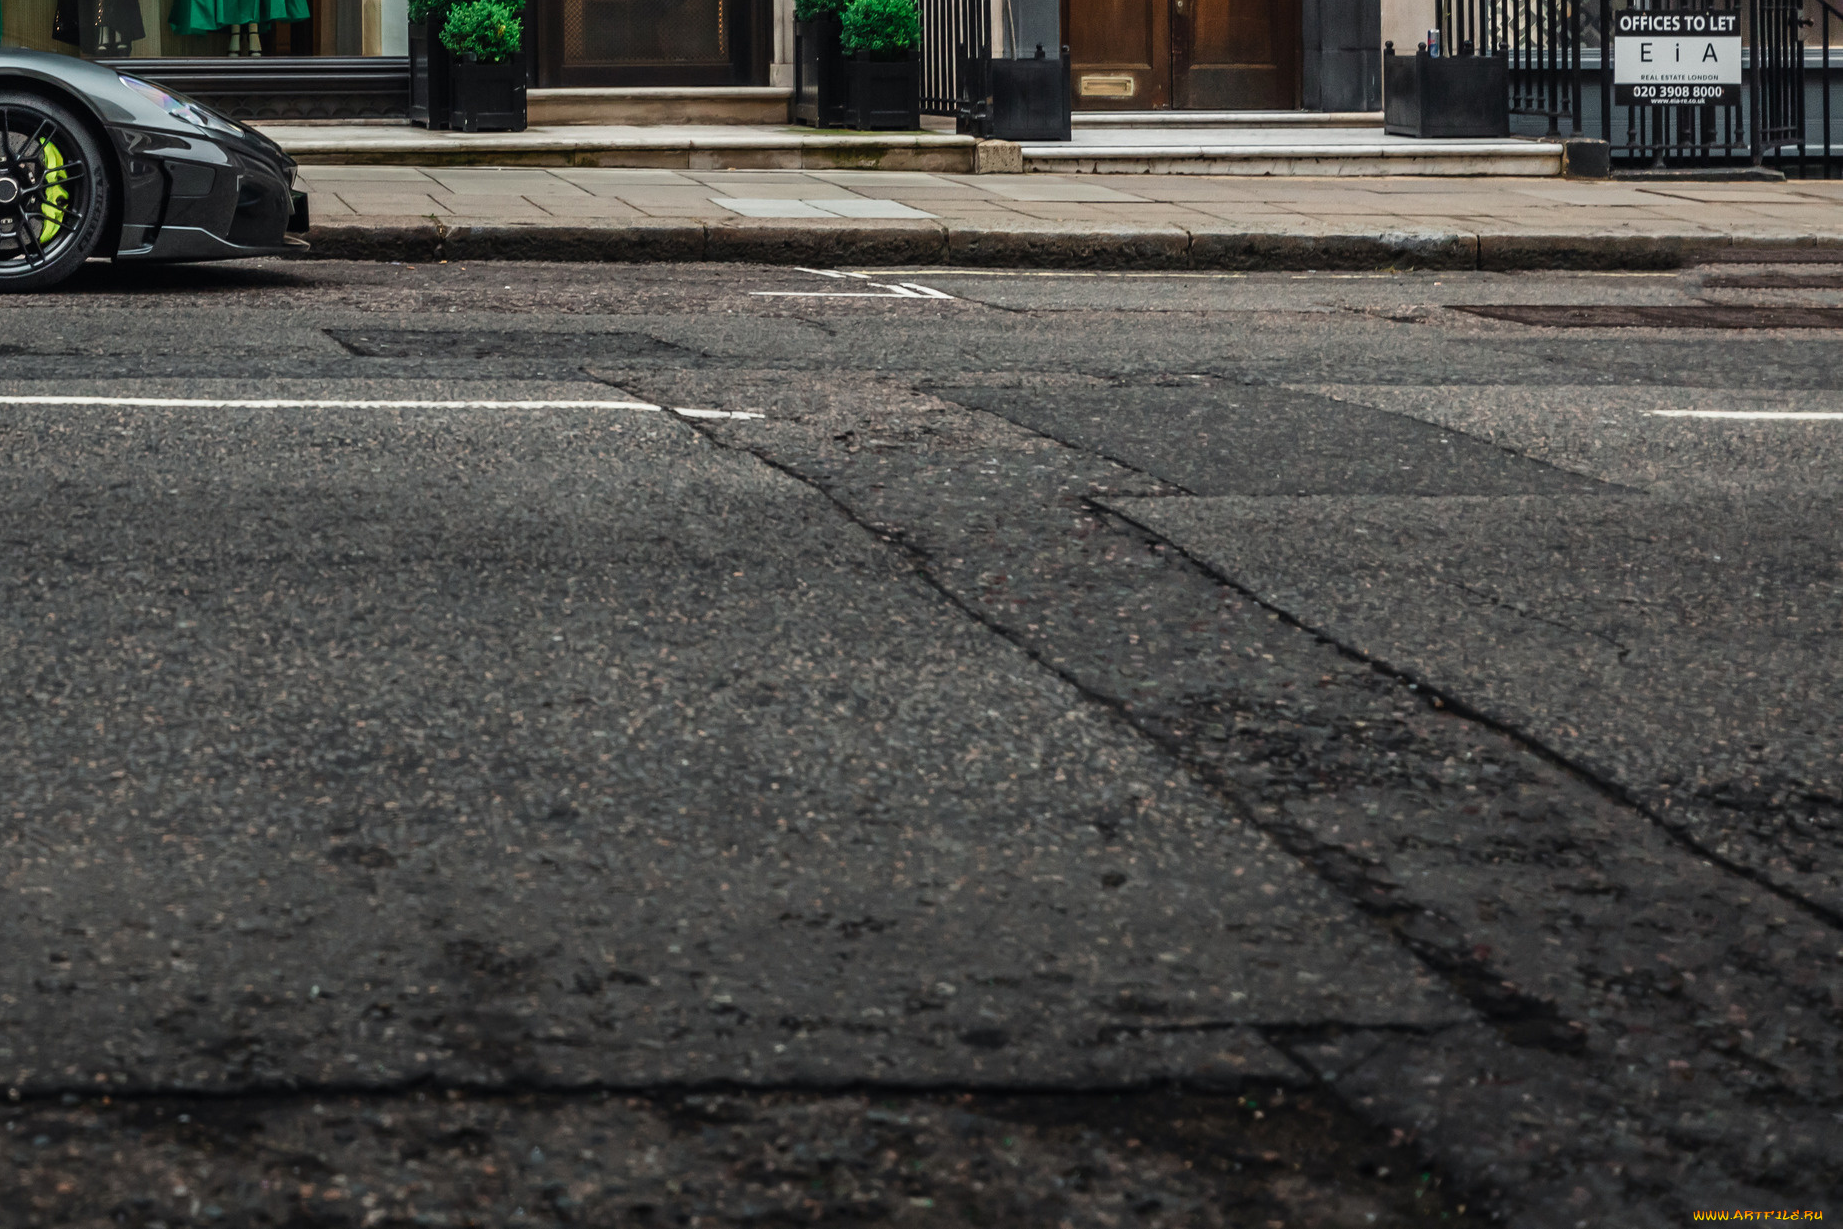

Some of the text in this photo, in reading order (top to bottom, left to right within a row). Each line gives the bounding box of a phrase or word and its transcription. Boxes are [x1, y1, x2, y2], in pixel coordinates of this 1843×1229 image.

[1619, 15, 1736, 31] OFFICES TO LET
[1633, 86, 1722, 97] 020 3908 8000
